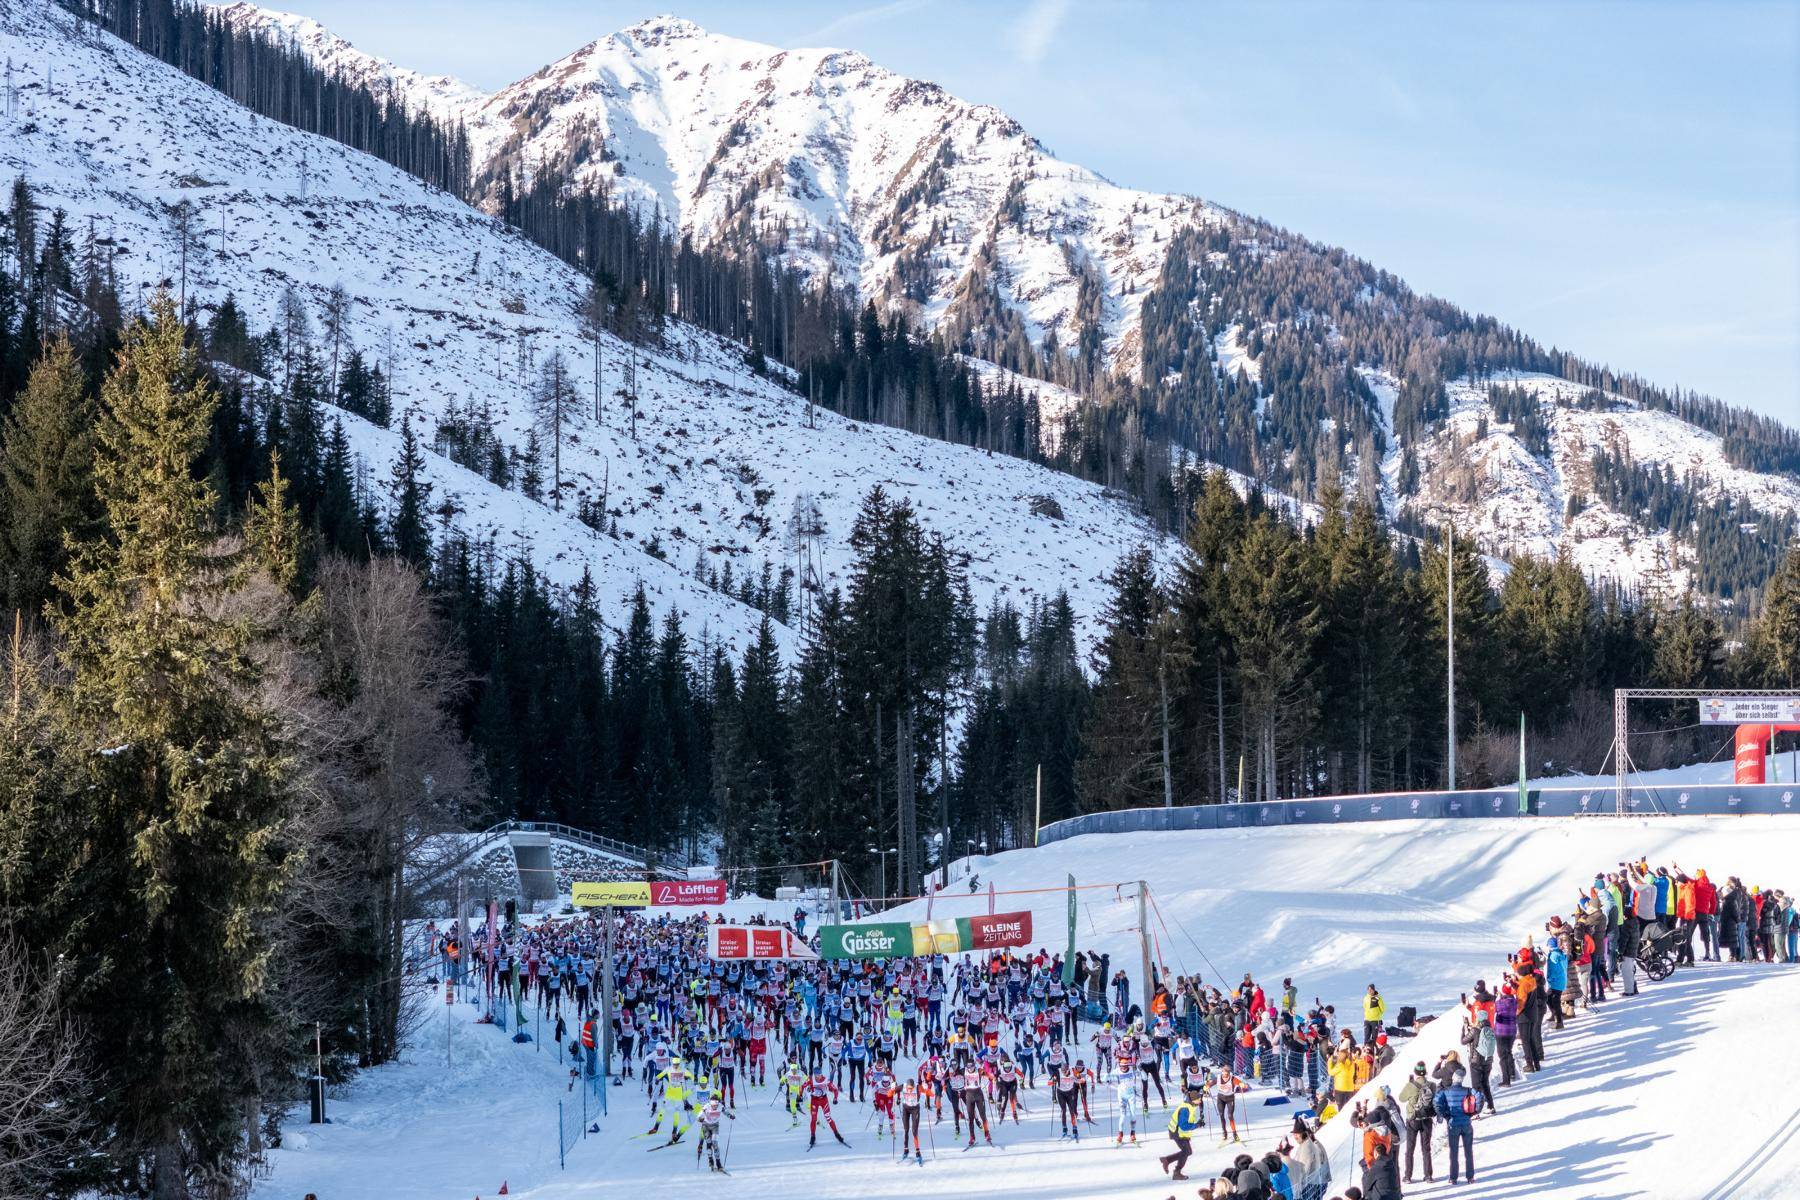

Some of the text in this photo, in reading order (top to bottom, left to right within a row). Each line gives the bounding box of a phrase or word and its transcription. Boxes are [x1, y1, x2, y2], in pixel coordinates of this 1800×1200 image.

[679, 884, 719, 894] Löffler
[982, 922, 1020, 933] KLEINE
[984, 931, 1022, 942] ZEITUNG
[842, 931, 895, 954] Gösser
